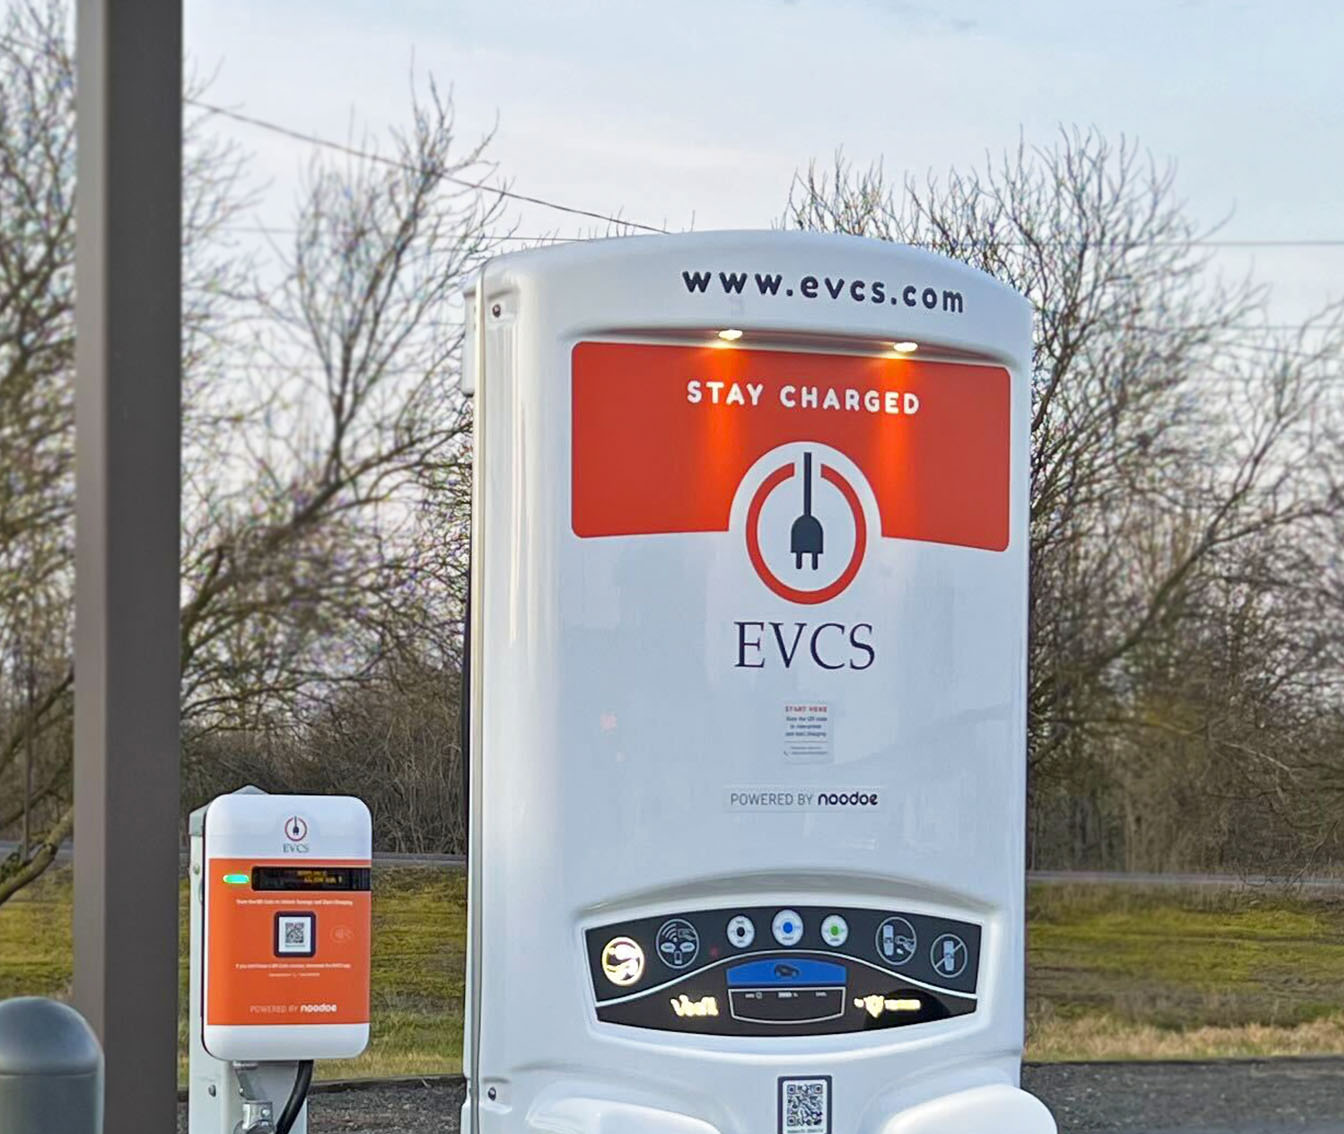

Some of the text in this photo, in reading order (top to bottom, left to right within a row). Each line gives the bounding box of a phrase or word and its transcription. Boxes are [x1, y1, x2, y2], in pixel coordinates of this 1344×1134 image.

[681, 270, 964, 314] www.evcs.com
[686, 379, 921, 416] STAY CHARGED
[732, 620, 876, 671] EVCS
[730, 791, 879, 807] POWERED BY noodoe
[282, 843, 310, 854] EVCS
[300, 1003, 337, 1014] noodoe
